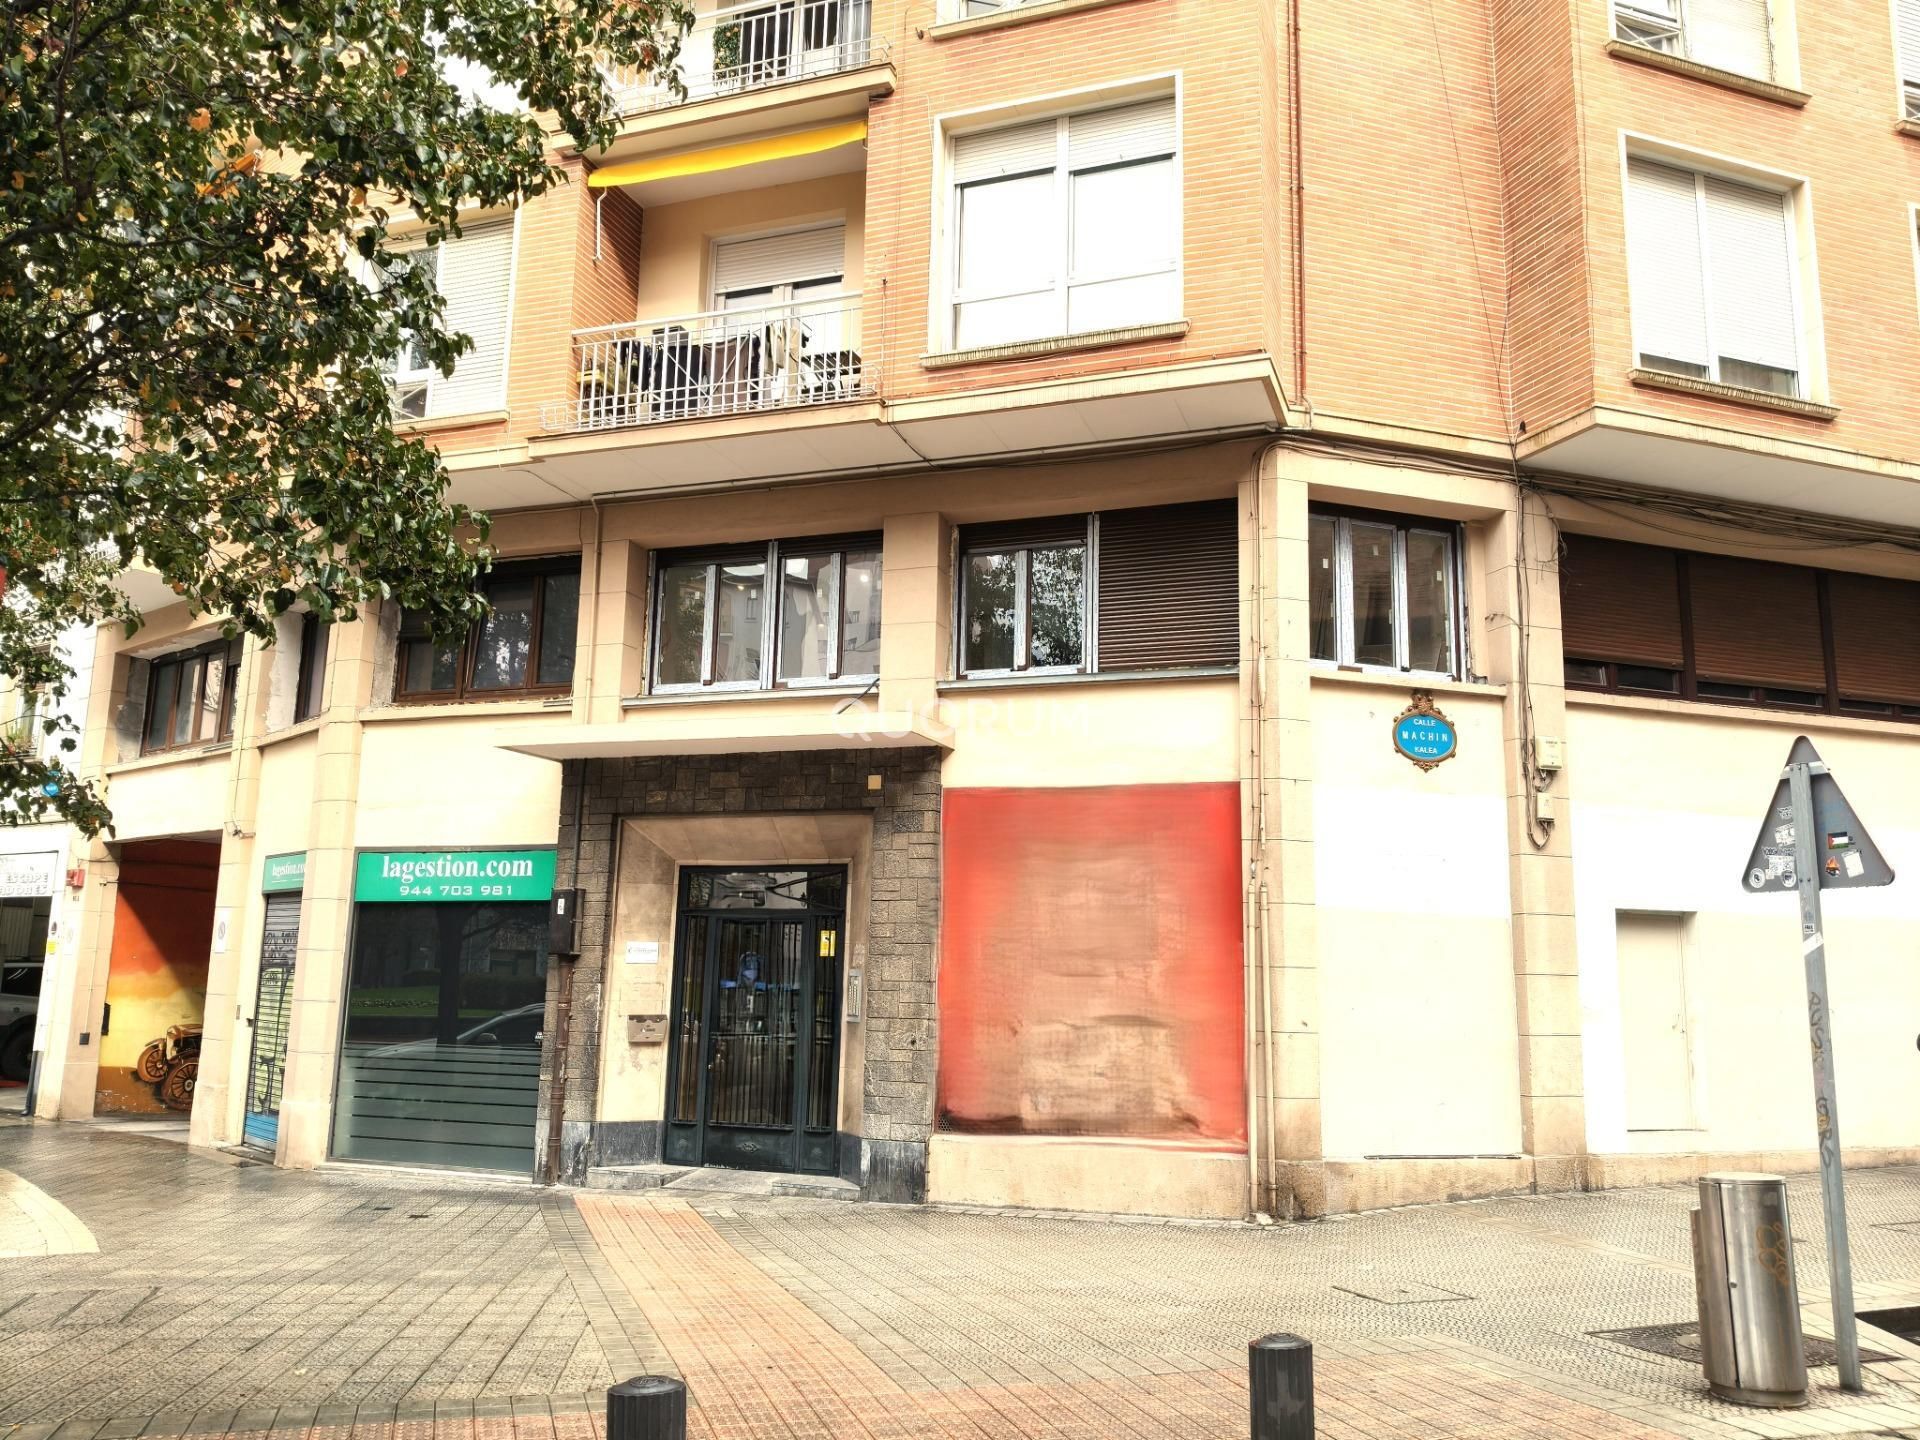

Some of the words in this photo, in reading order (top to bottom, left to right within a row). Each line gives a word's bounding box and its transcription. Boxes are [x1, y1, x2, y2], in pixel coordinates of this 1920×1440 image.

[1402, 730, 1448, 742] MACHIN
[1414, 746, 1438, 754] KALEA
[382, 855, 533, 884] lagestion.com
[399, 885, 433, 896] 944
[440, 885, 473, 896] 703
[480, 885, 513, 896] 981
